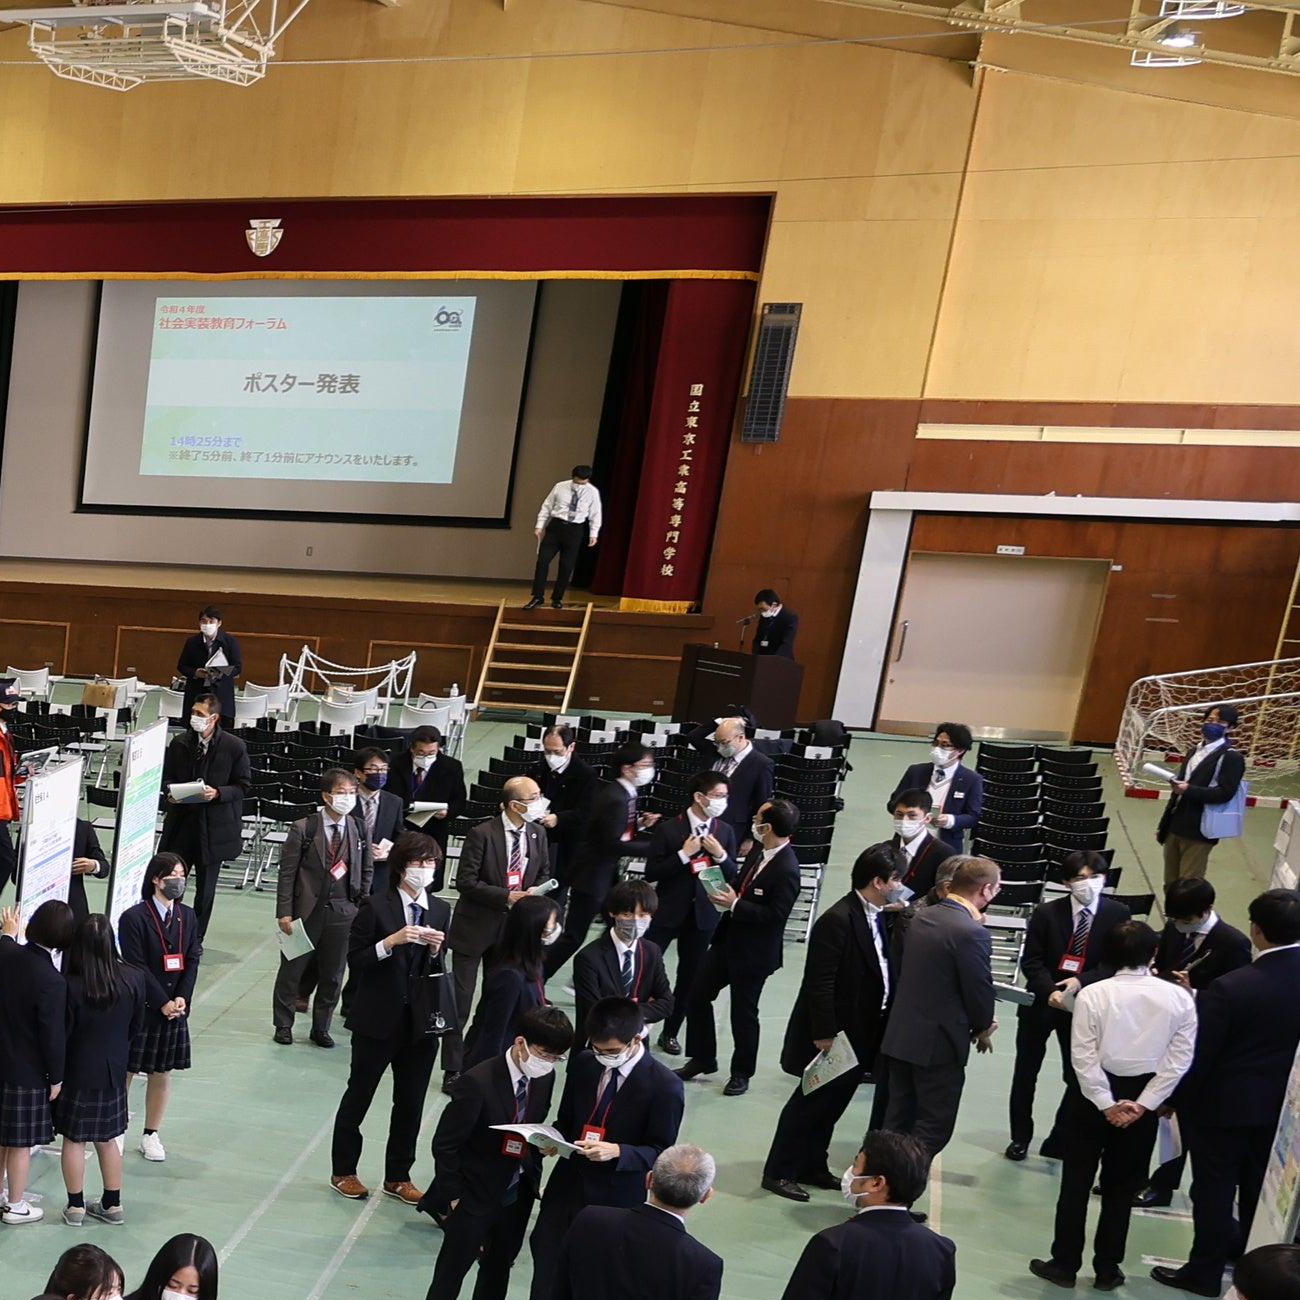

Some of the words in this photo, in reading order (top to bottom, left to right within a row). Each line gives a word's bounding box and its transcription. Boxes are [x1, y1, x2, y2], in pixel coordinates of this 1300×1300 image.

[159, 304, 206, 314] 令和４年度
[158, 316, 288, 331] 社会実装教育フォーラム
[242, 372, 361, 395] ポスター発表
[169, 435, 243, 448] 14時25分まで
[659, 383, 704, 577] 国立東京工業高等専門学校
